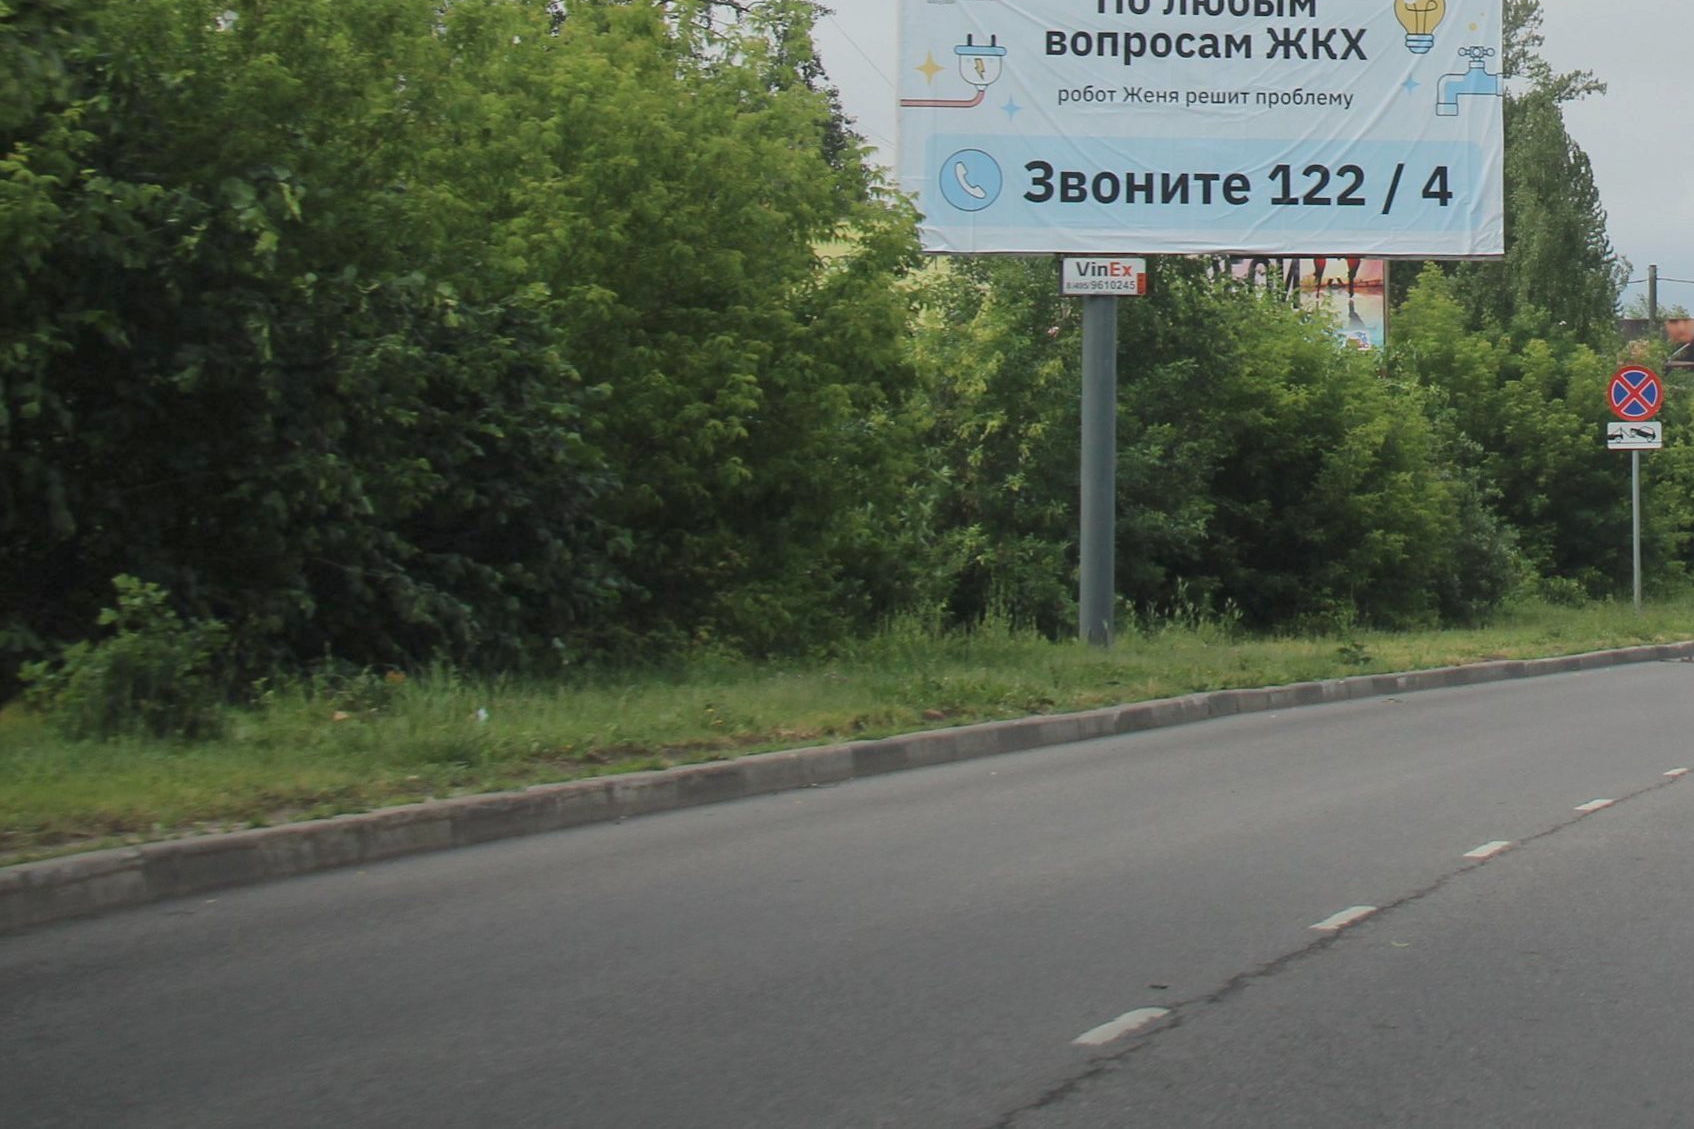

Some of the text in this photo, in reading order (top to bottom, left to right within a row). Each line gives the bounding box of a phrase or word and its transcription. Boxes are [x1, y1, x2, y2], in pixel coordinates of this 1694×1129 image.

[1045, 27, 1368, 66] вопросам ЖКХ
[1058, 84, 1354, 110] робот Женя решит проблему
[1023, 160, 1453, 215] Звоните 122 / 4
[1076, 262, 1132, 277] VinEx
